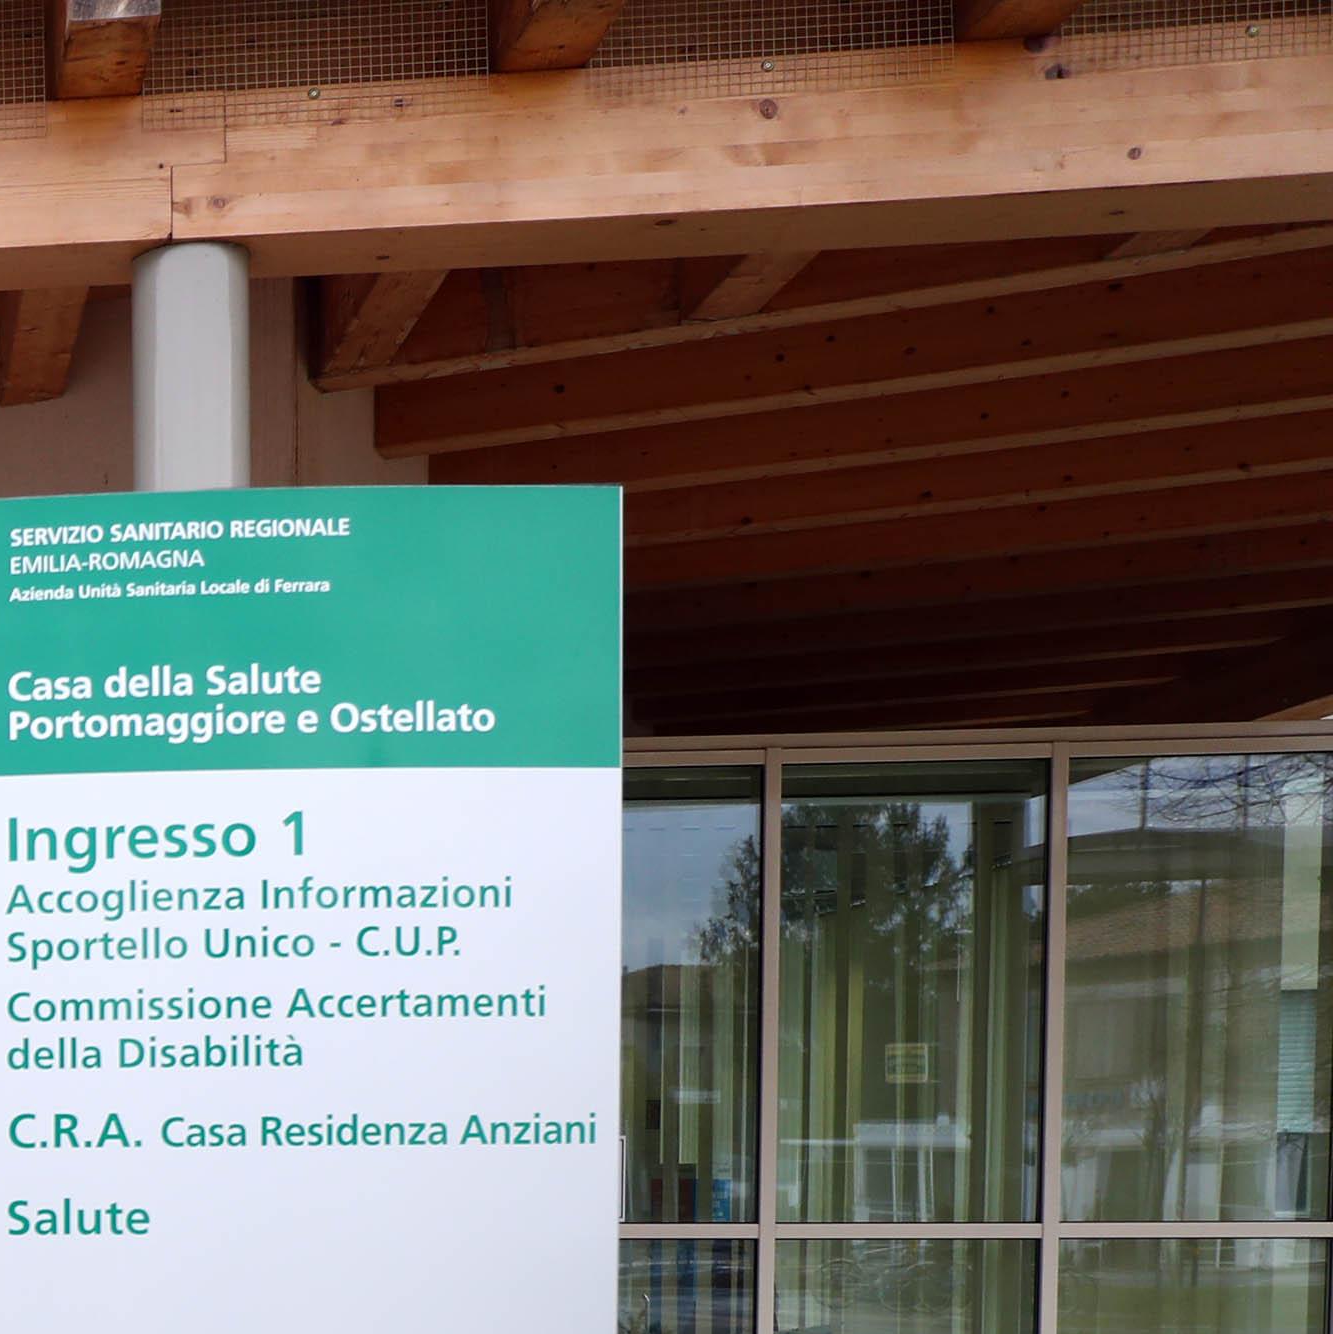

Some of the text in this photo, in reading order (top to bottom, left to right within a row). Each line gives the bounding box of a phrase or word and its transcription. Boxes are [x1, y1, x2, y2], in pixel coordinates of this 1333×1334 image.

[10, 517, 350, 547] SERVIZIO SANITARIO REGIONALE
[10, 549, 205, 575] EMILIA-ROMAGNA
[9, 578, 331, 602] Azienda Unità Sanitaria Locale di Ferrara
[8, 662, 322, 702] Casa della Salute
[9, 699, 496, 744] Portomaggiore e Ostellato
[6, 811, 305, 873] Ingresso 1
[6, 876, 513, 921] Accoglienza Informazioni
[6, 926, 461, 970] Sportello Unico - C.U.P.
[6, 985, 546, 1024] Commissione Accertamenti
[6, 1035, 303, 1070] della Disabilità
[8, 1113, 598, 1149] C.R.A. Casa Residenza Anziani
[7, 1199, 151, 1236] Salute
